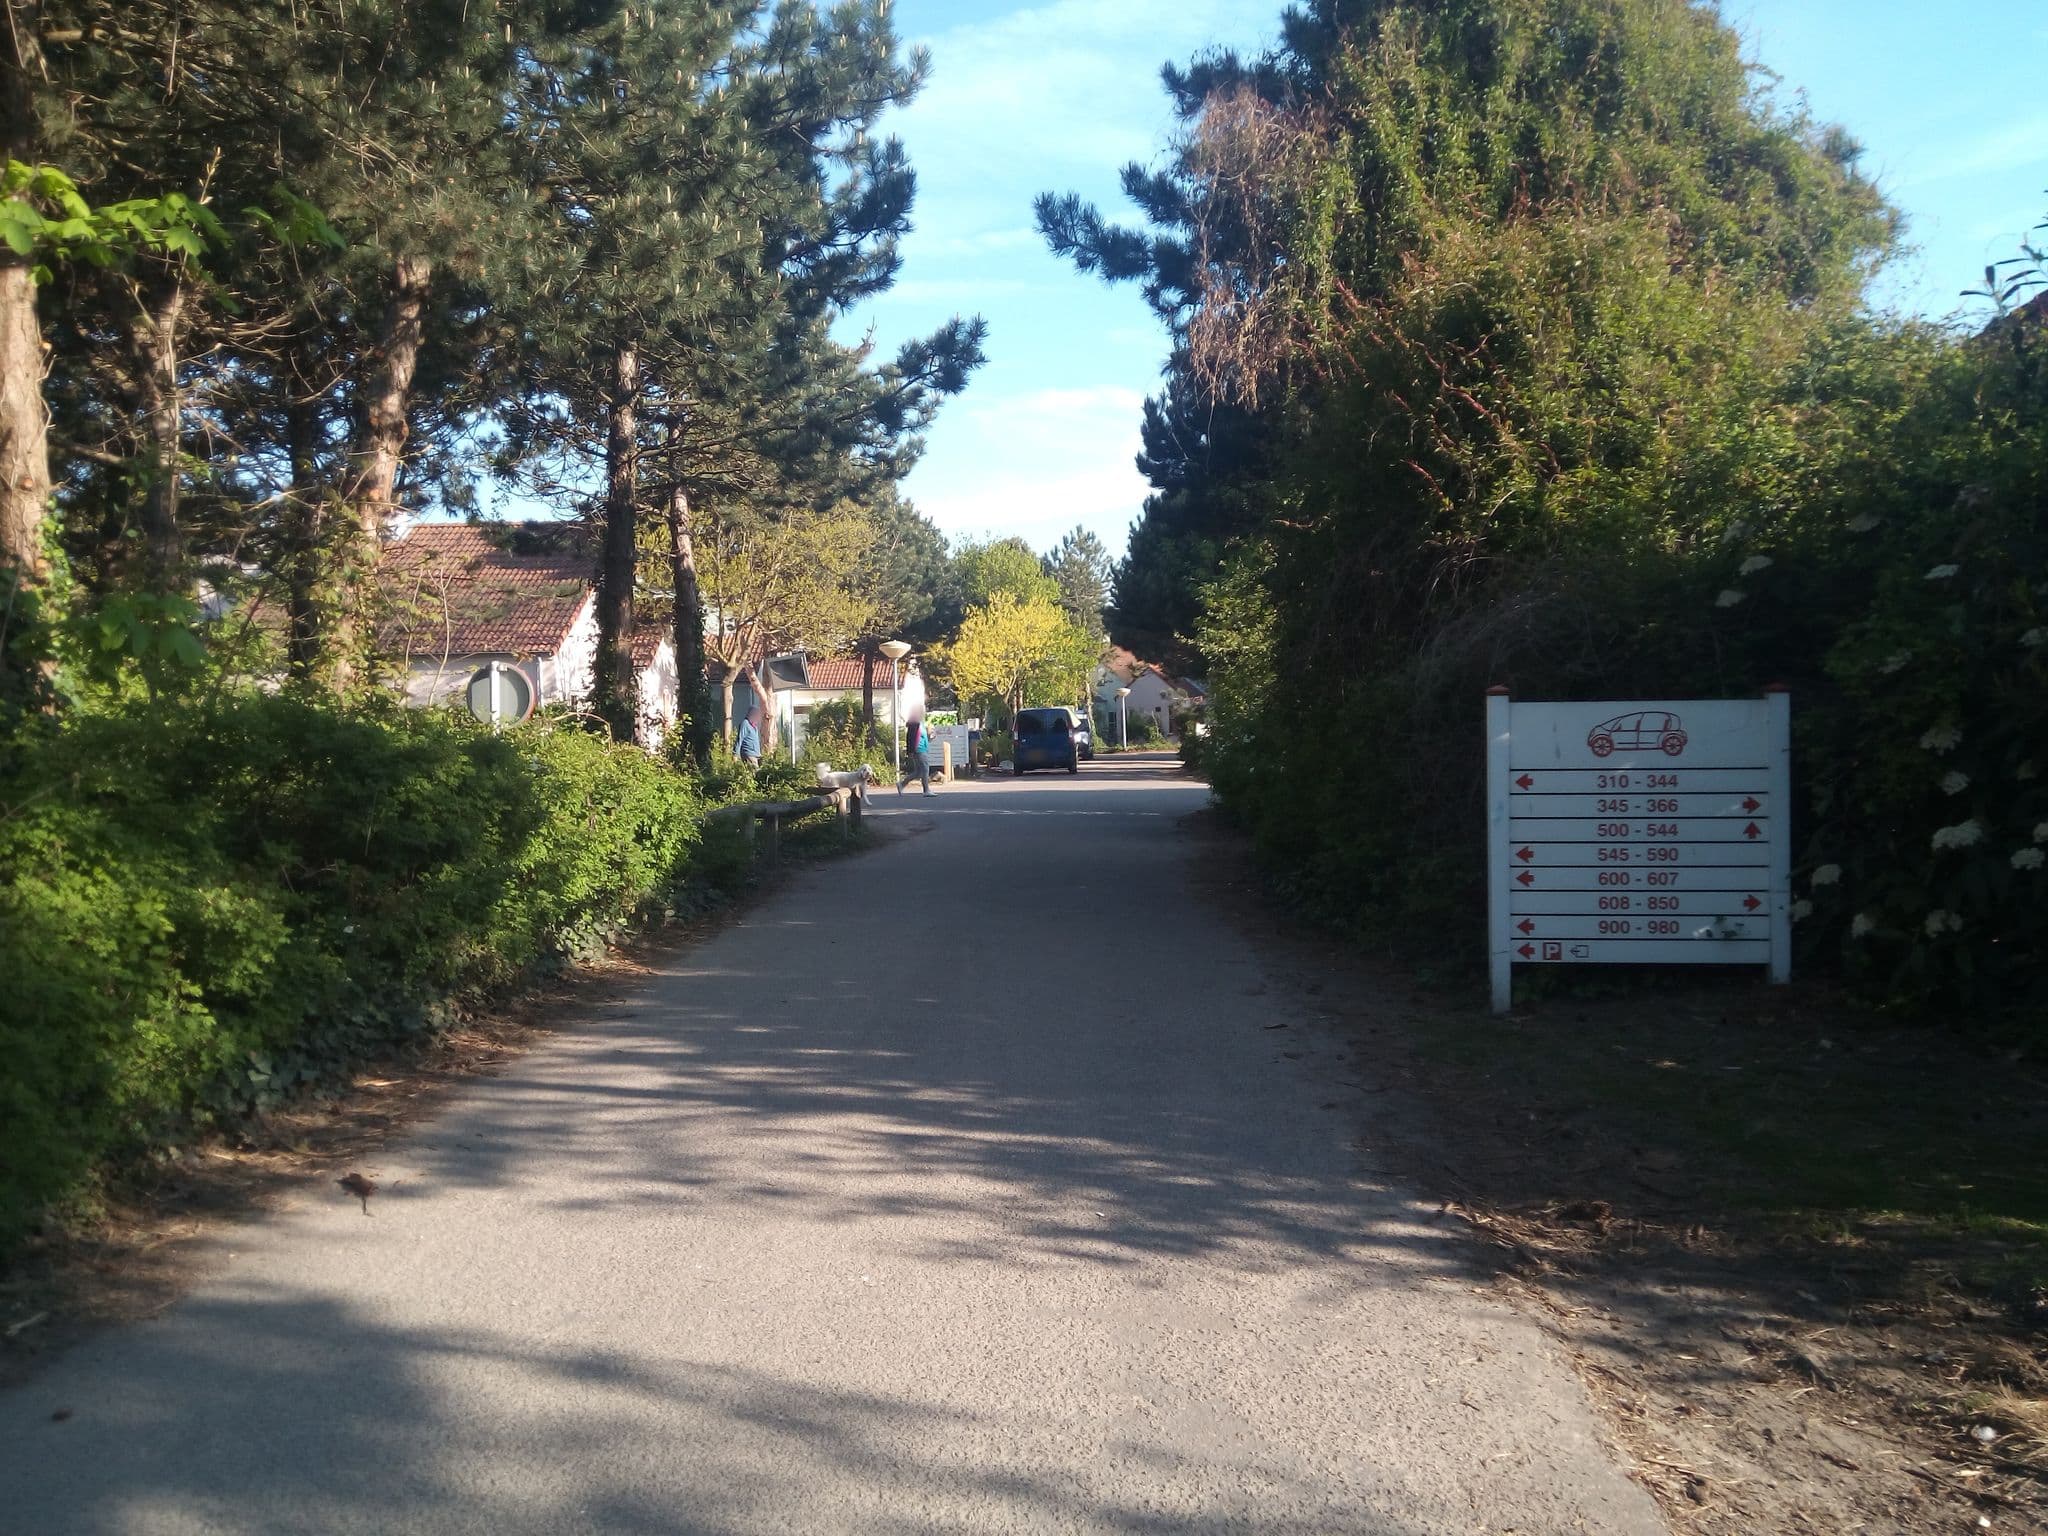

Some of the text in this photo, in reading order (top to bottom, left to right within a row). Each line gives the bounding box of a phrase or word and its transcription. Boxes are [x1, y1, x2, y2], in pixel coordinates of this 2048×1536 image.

[1597, 774, 1630, 789] 310
[1646, 774, 1679, 789] 344
[1597, 798, 1630, 813] 345
[1646, 798, 1679, 813] 366
[1597, 822, 1630, 837] 500
[1646, 822, 1679, 837] 544
[1597, 847, 1630, 861] 545
[1646, 847, 1679, 861] 590
[1598, 871, 1631, 886] 600
[1647, 871, 1680, 886] 607
[1598, 895, 1631, 910] 608
[1647, 895, 1680, 910] 850
[1598, 919, 1631, 934] 900
[1647, 919, 1680, 934] 980
[1545, 943, 1560, 959] P
